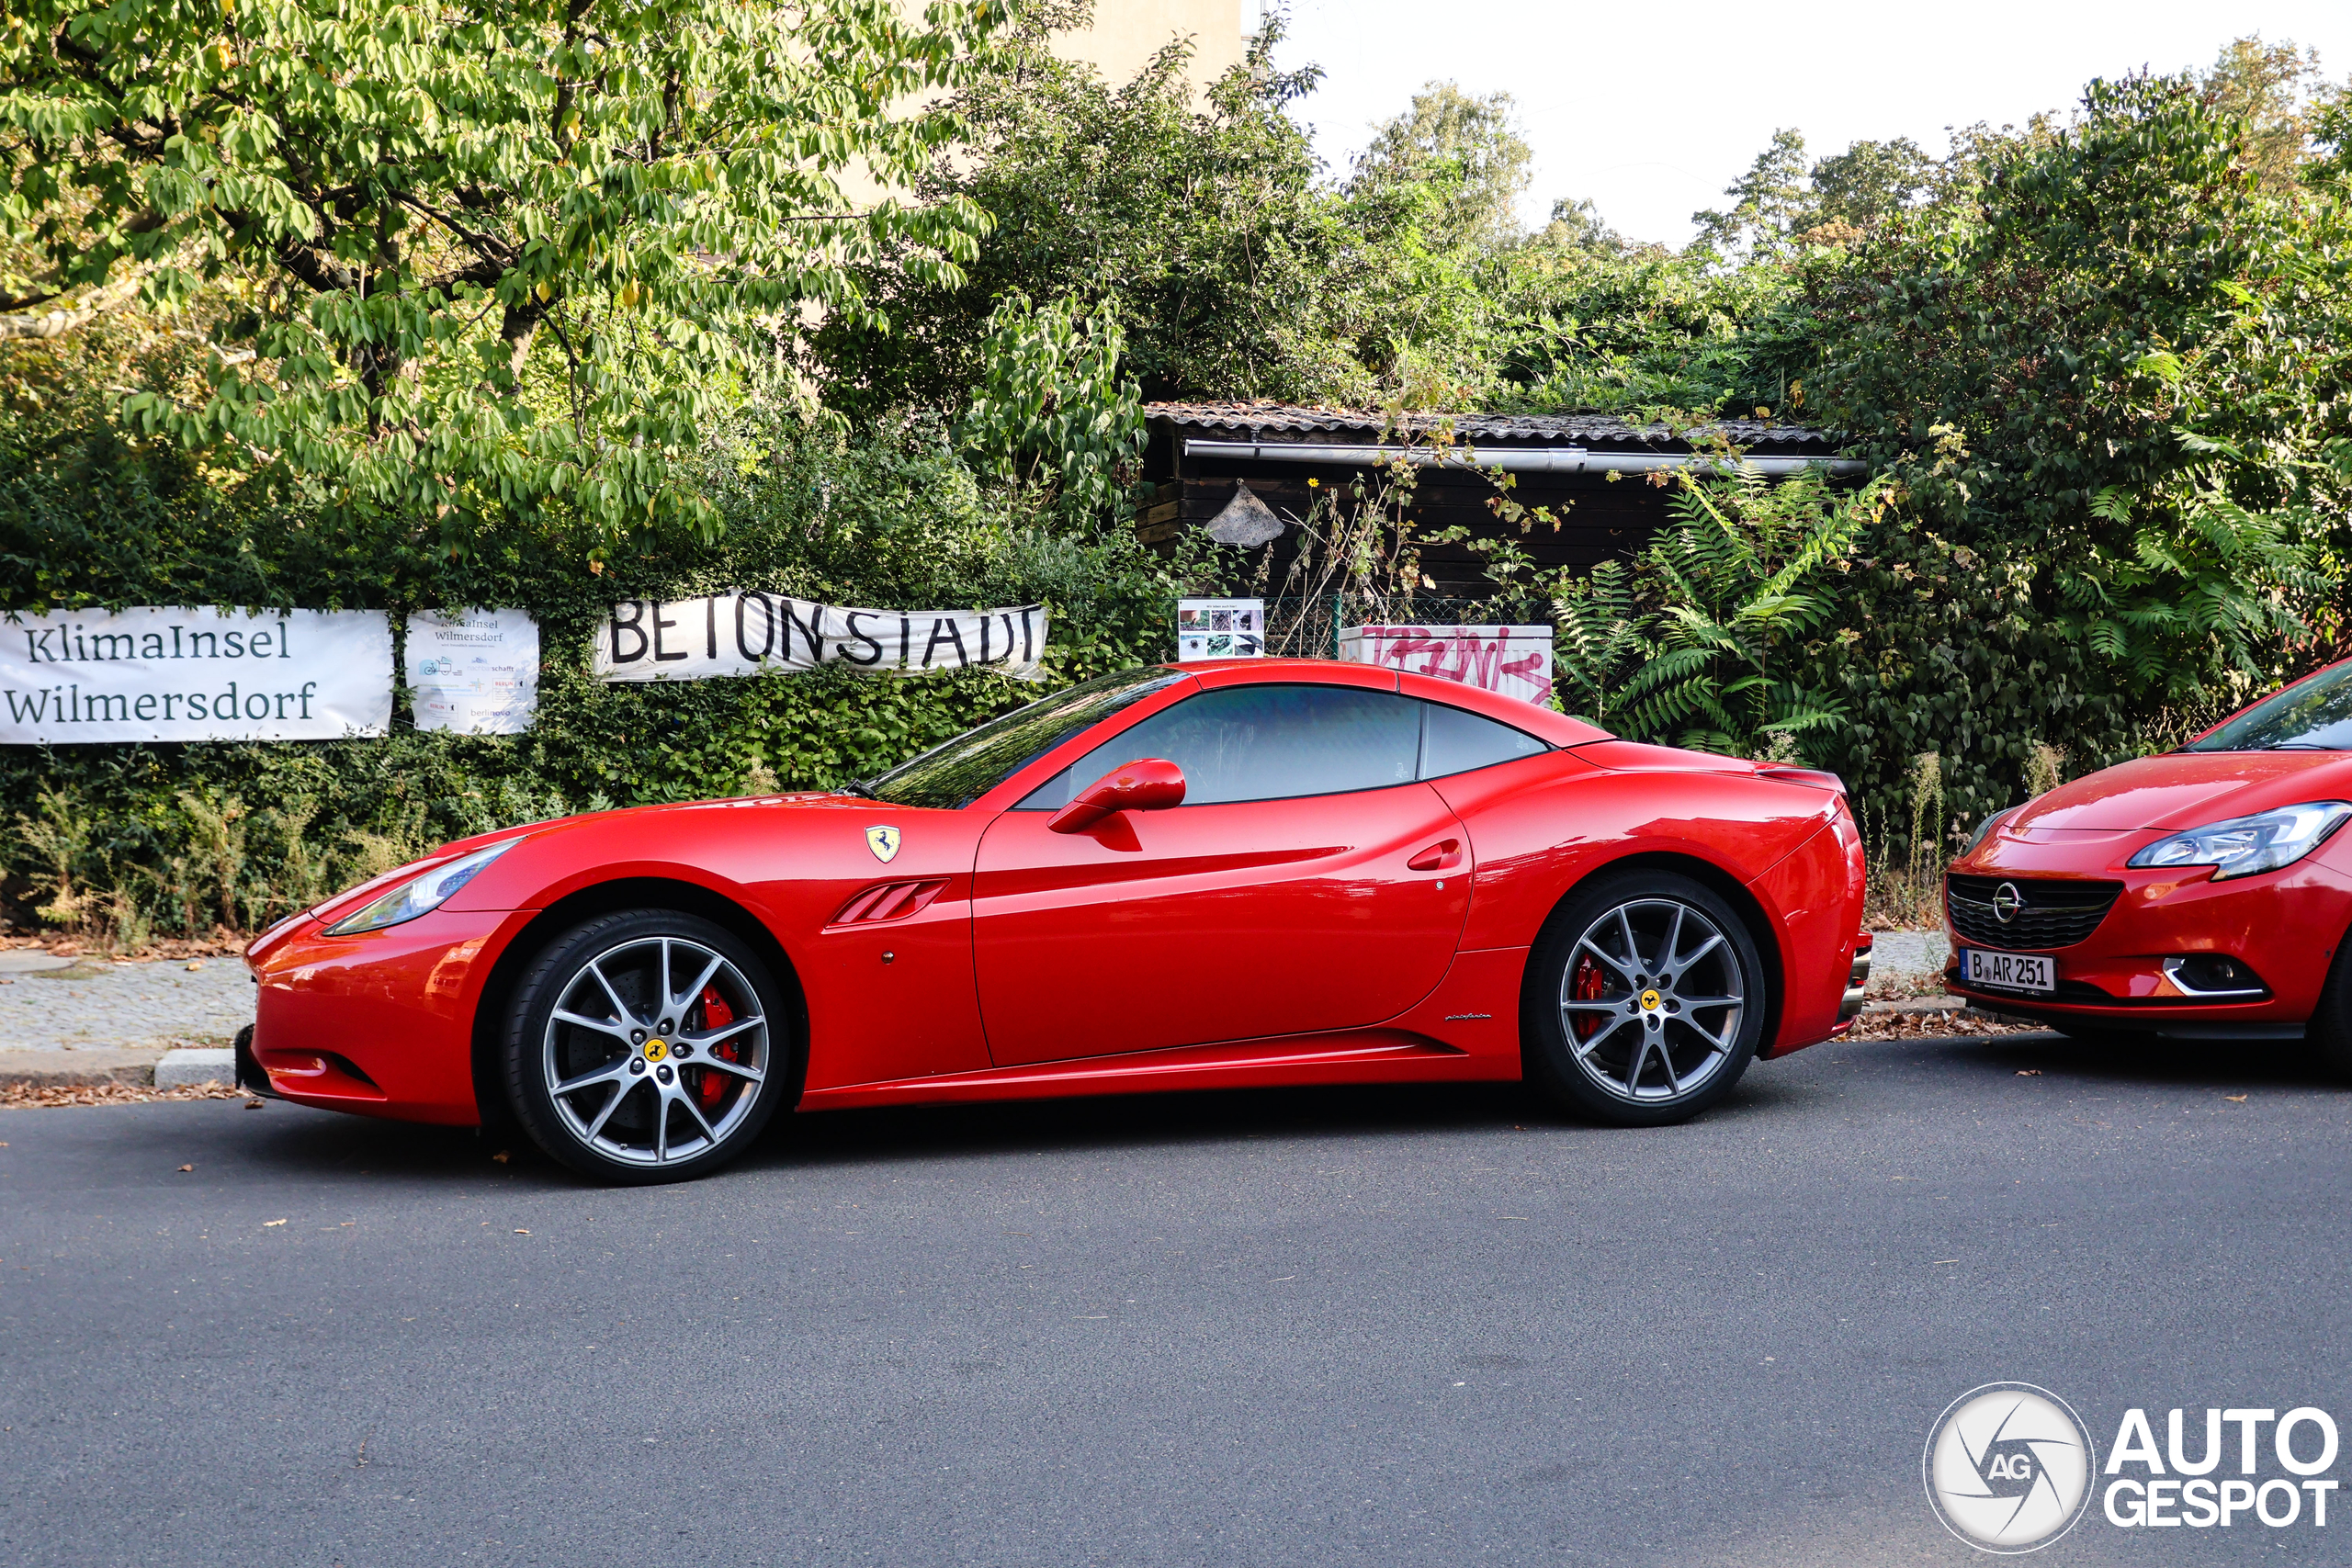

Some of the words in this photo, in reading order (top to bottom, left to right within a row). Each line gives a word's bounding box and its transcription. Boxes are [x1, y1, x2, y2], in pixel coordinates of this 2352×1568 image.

[25, 621, 292, 664] KlimaInsel
[435, 631, 503, 642] Wilmersdorf
[4, 681, 318, 725] Wilmersdorf
[1973, 953, 1983, 978] B
[1993, 956, 2012, 982] AR
[2016, 958, 2048, 987] 251
